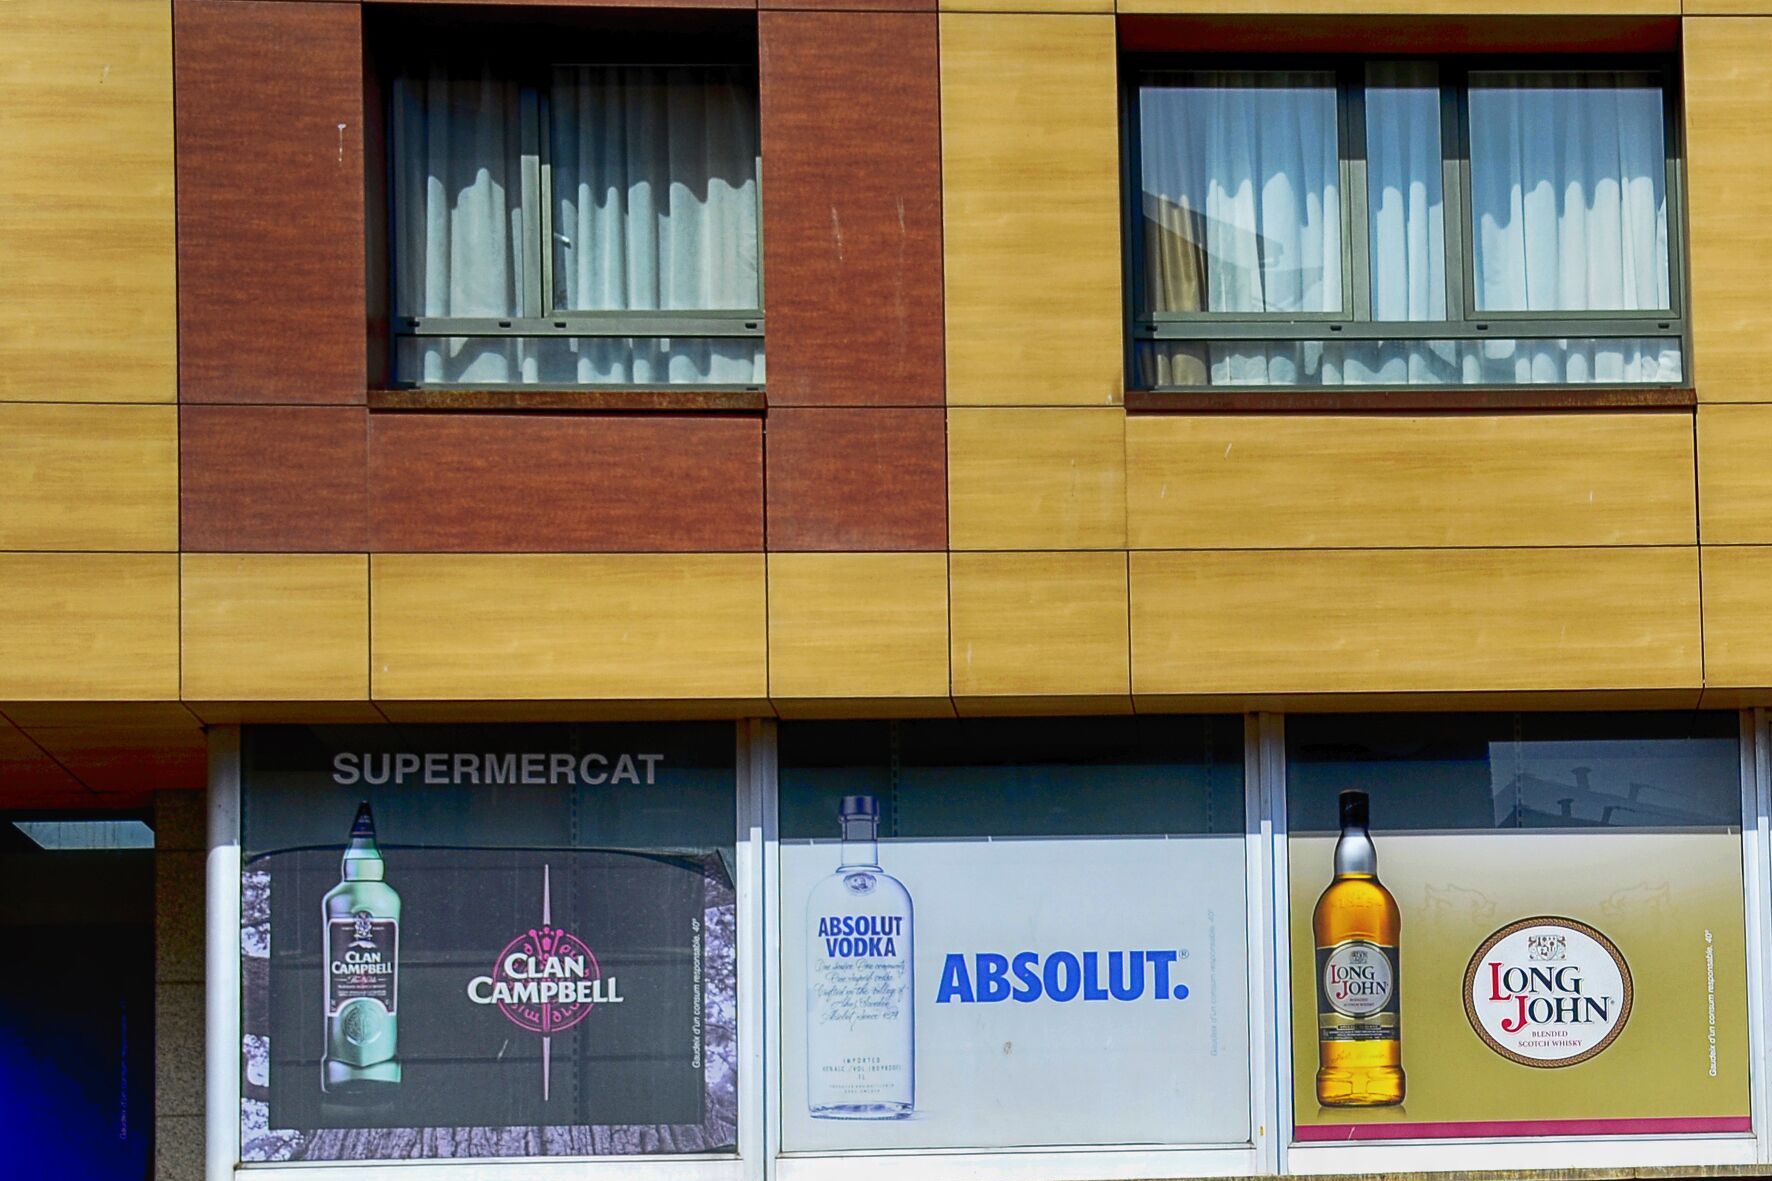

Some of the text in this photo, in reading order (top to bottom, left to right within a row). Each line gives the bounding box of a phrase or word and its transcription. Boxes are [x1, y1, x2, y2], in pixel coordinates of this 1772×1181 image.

[332, 752, 664, 785] SUPERMERCAT
[817, 915, 902, 937] ABSOLUT
[345, 951, 381, 963] CLAN
[825, 937, 897, 958] VODKA
[332, 961, 392, 974] CAMPBELL
[503, 952, 585, 980] CLAN
[936, 950, 1190, 1003] ABSOLUT.
[1330, 964, 1375, 984] LONG
[467, 976, 624, 1005] CAMPBELL
[1336, 980, 1387, 1000] JOHN
[1488, 962, 1580, 1002] LONG
[692, 984, 701, 1016] consum
[1707, 994, 1715, 1025] consum
[691, 1017, 701, 1035] d'un
[1501, 996, 1612, 1034] JOHN
[1518, 1039, 1583, 1048] SCOTCH WHISKY
[1531, 1030, 1569, 1039] BLENDED
[1707, 1026, 1716, 1044] d'un
[691, 1036, 702, 1069] Gaudeix
[1708, 1045, 1717, 1077] Gaudeix
